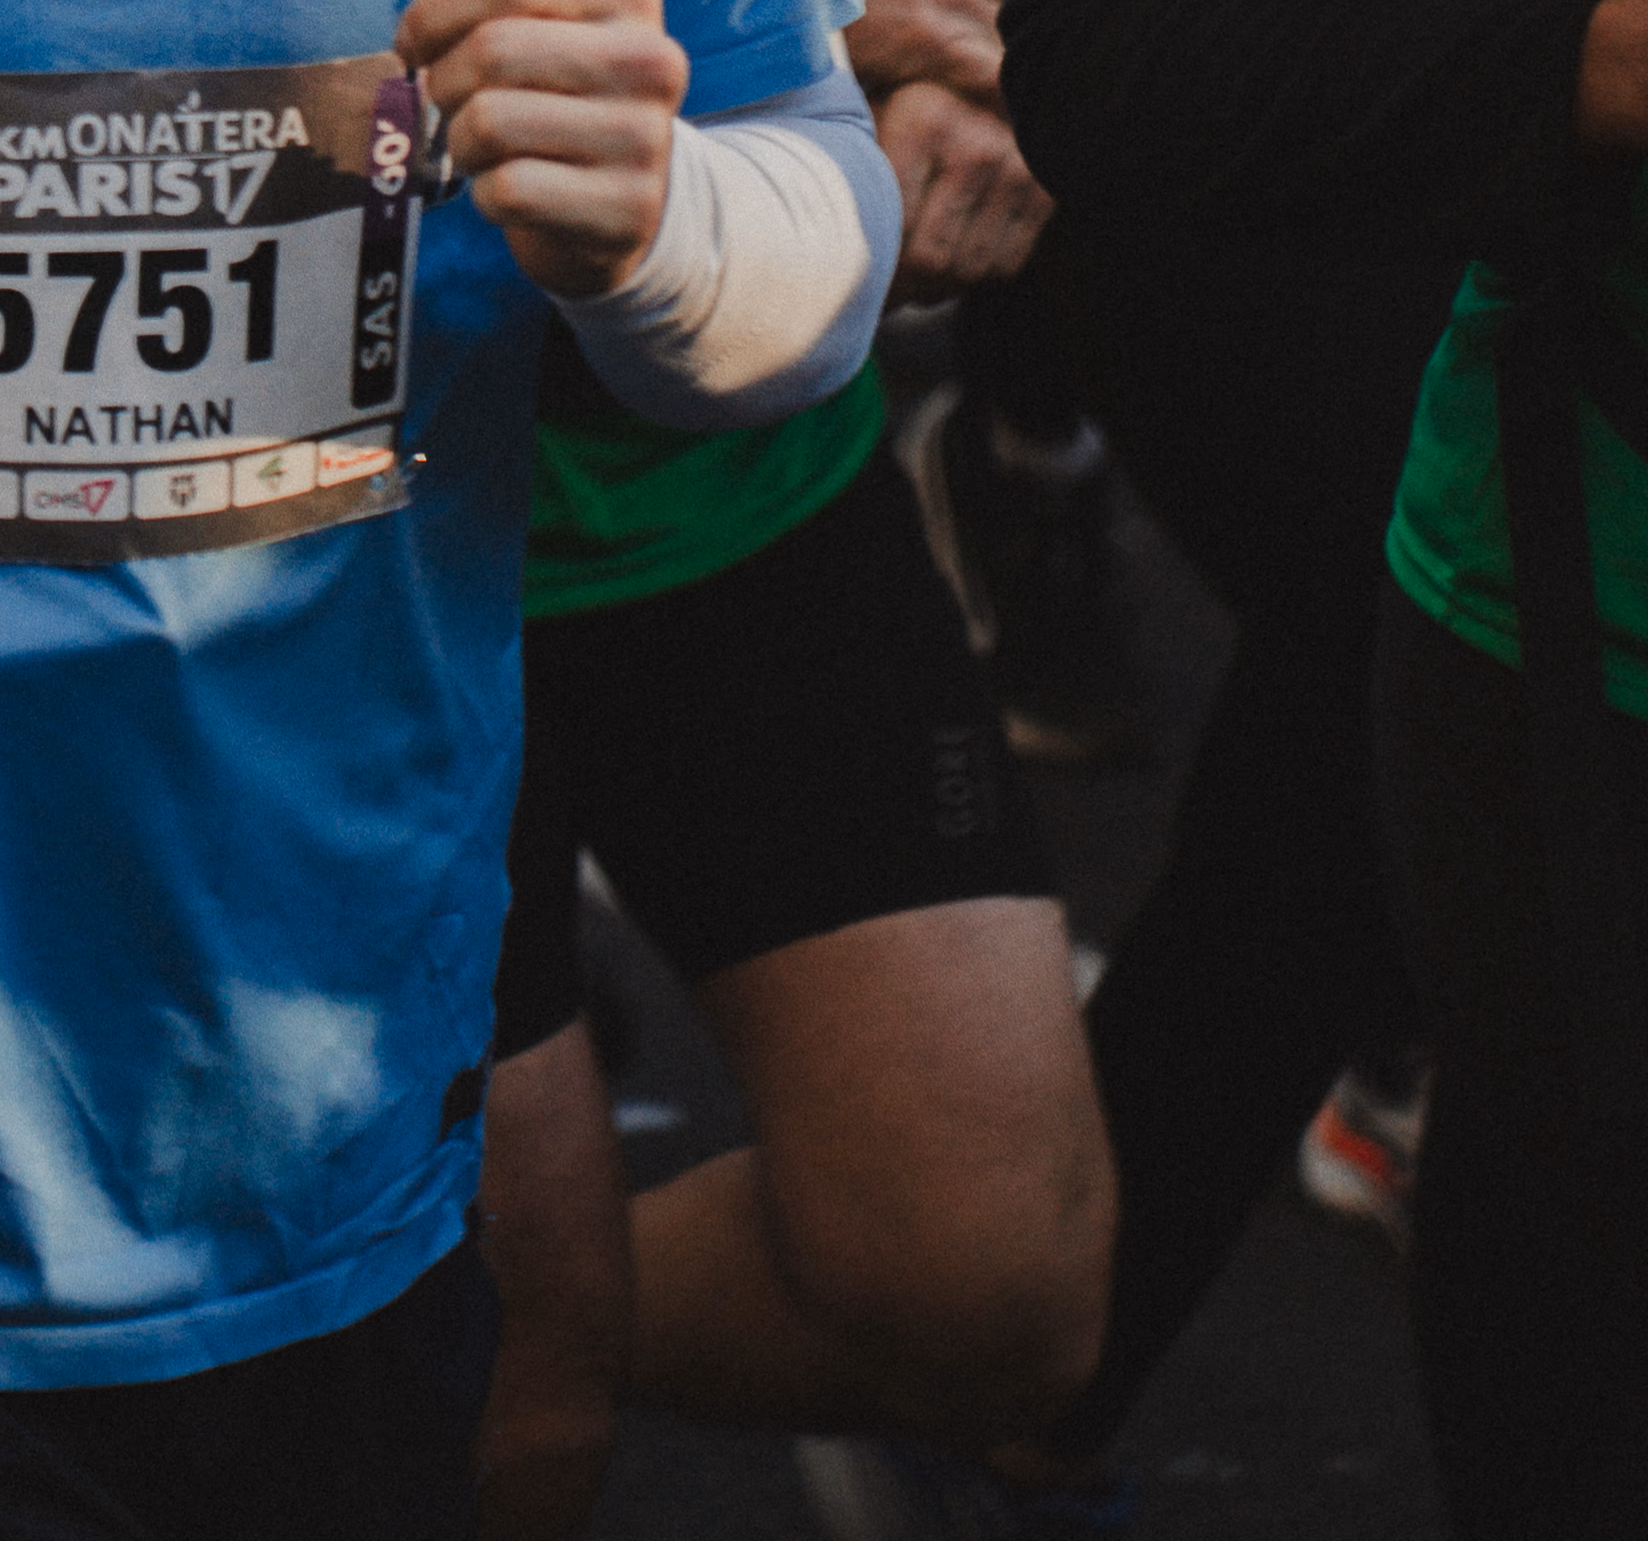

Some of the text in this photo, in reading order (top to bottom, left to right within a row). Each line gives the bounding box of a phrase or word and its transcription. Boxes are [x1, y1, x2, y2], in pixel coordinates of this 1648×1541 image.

[67, 105, 311, 157] ONATERA
[360, 270, 399, 370] SAS
[23, 396, 234, 445] NATHAN
